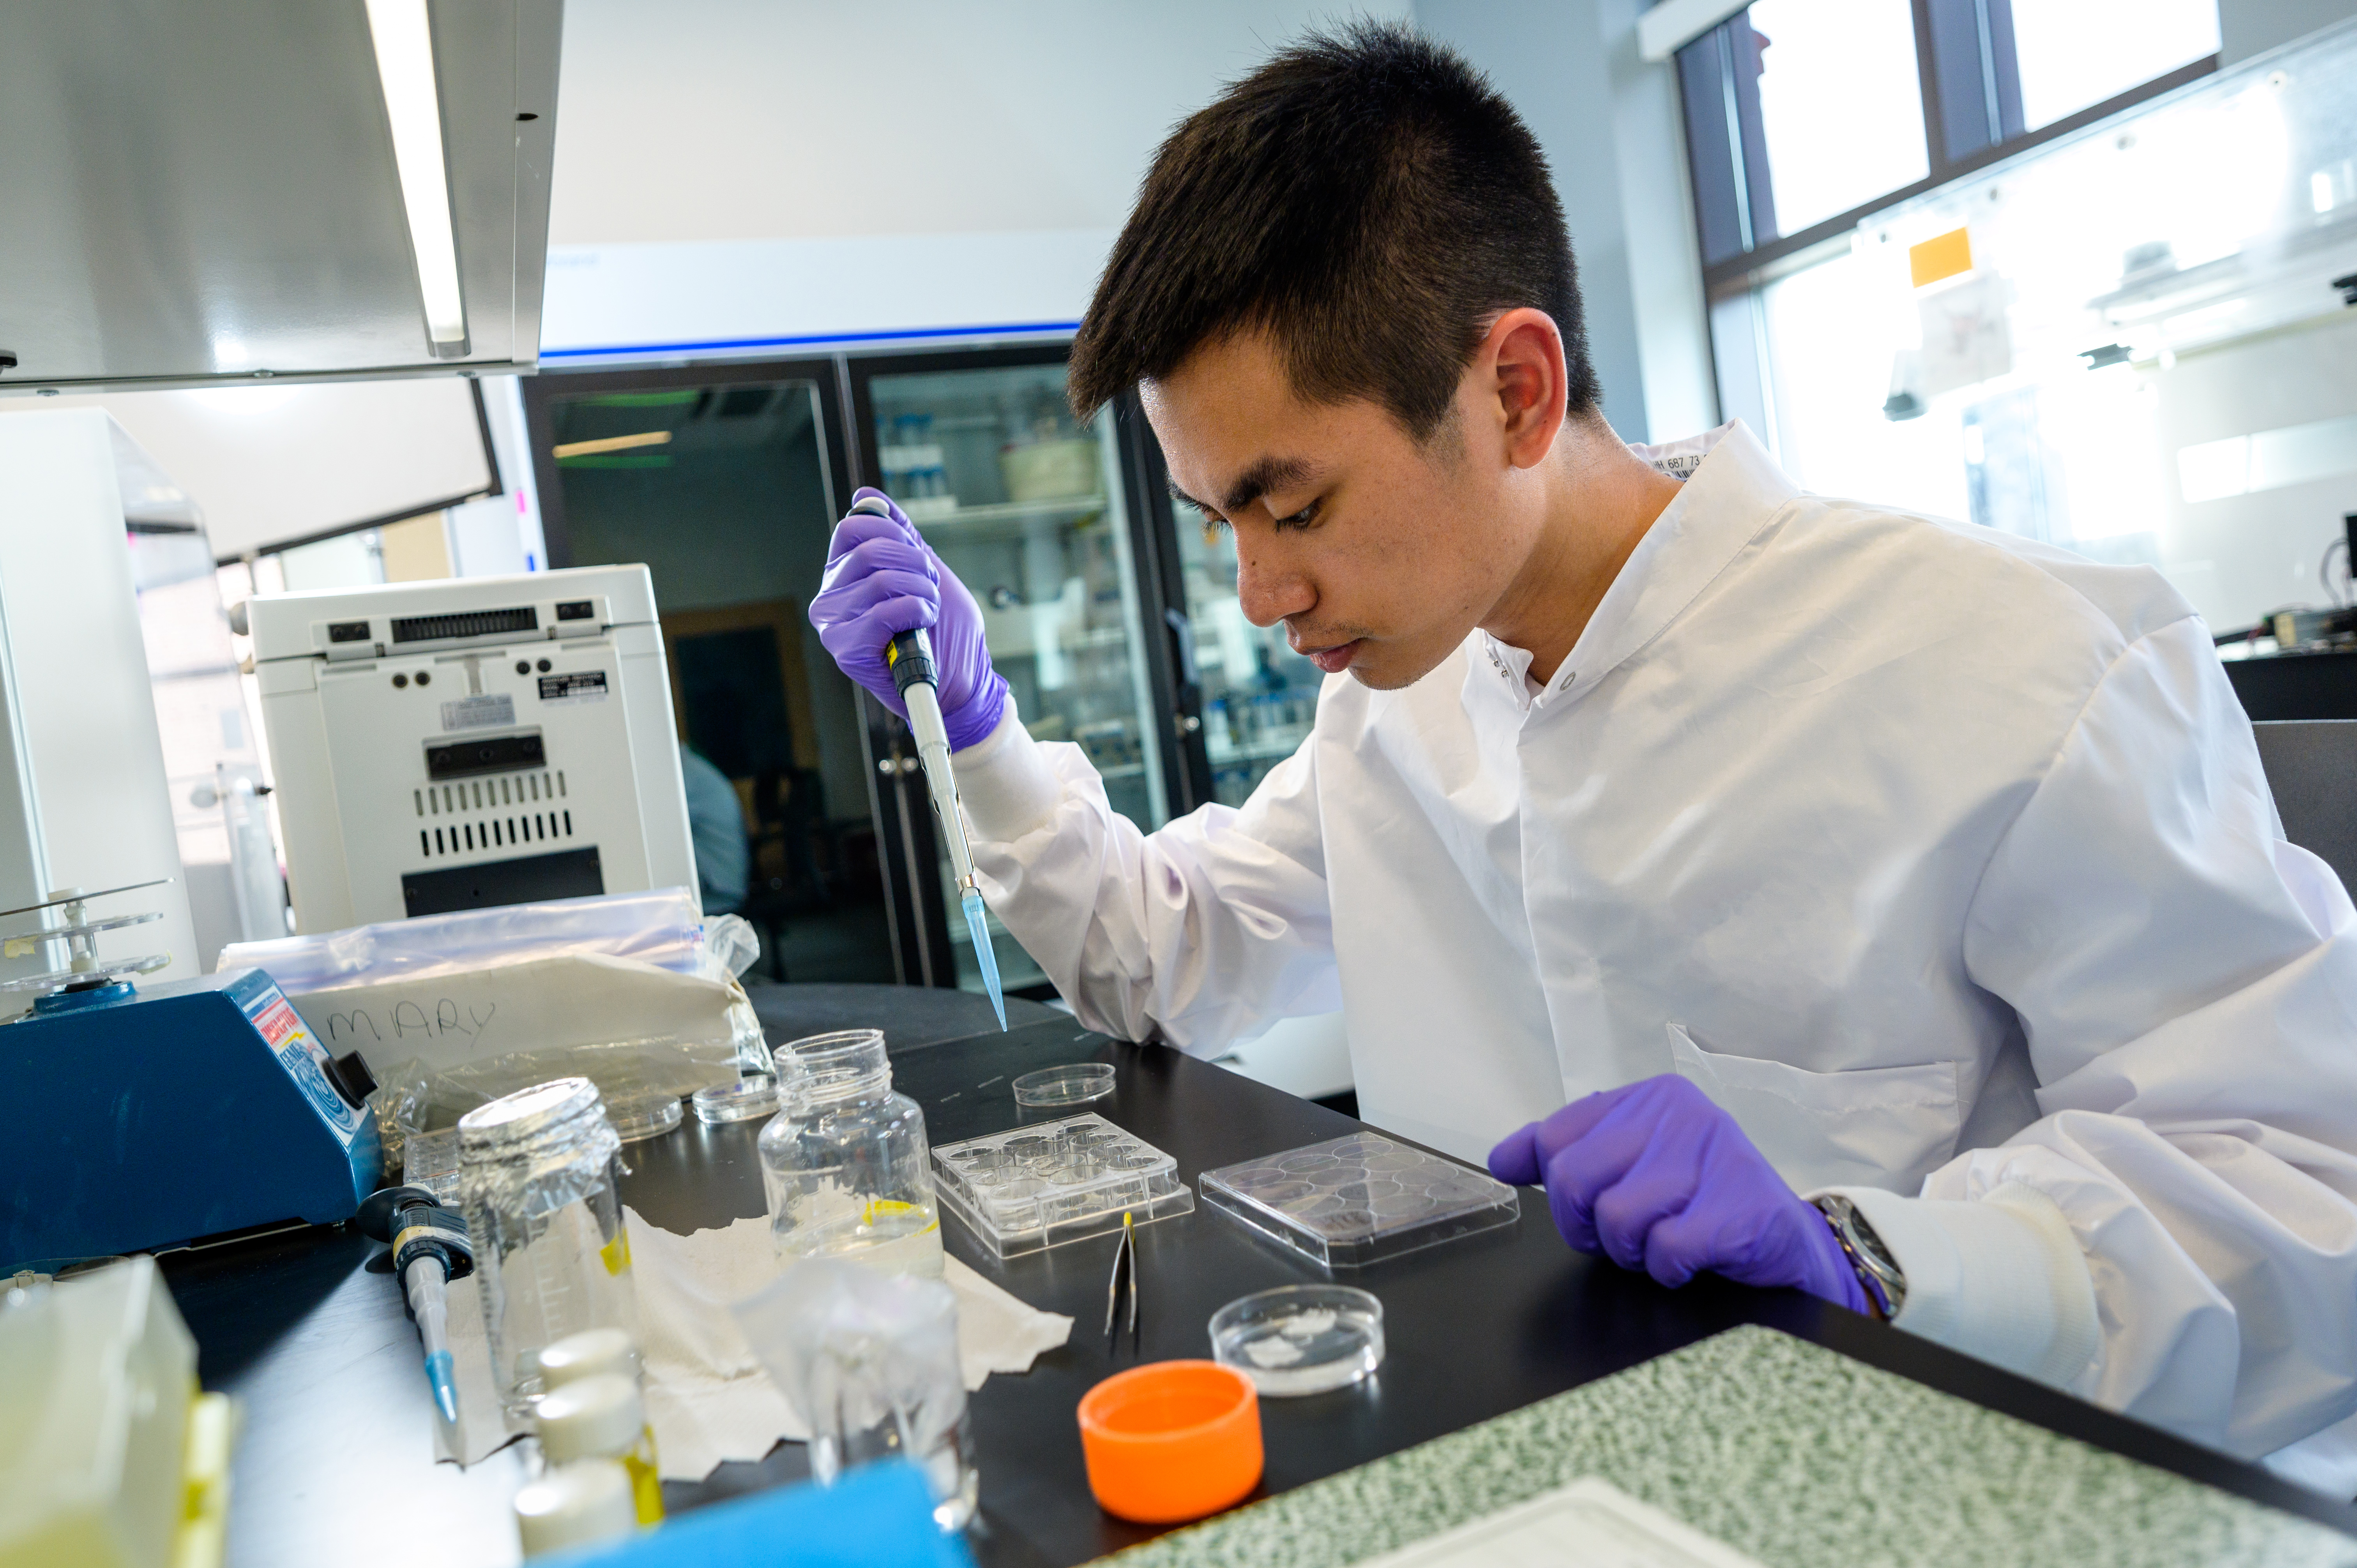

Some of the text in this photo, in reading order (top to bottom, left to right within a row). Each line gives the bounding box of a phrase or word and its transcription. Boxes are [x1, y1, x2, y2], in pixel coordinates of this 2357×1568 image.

[1668, 457, 1683, 468] 687
[1689, 455, 1700, 466] 73
[327, 998, 496, 1050] MARY
